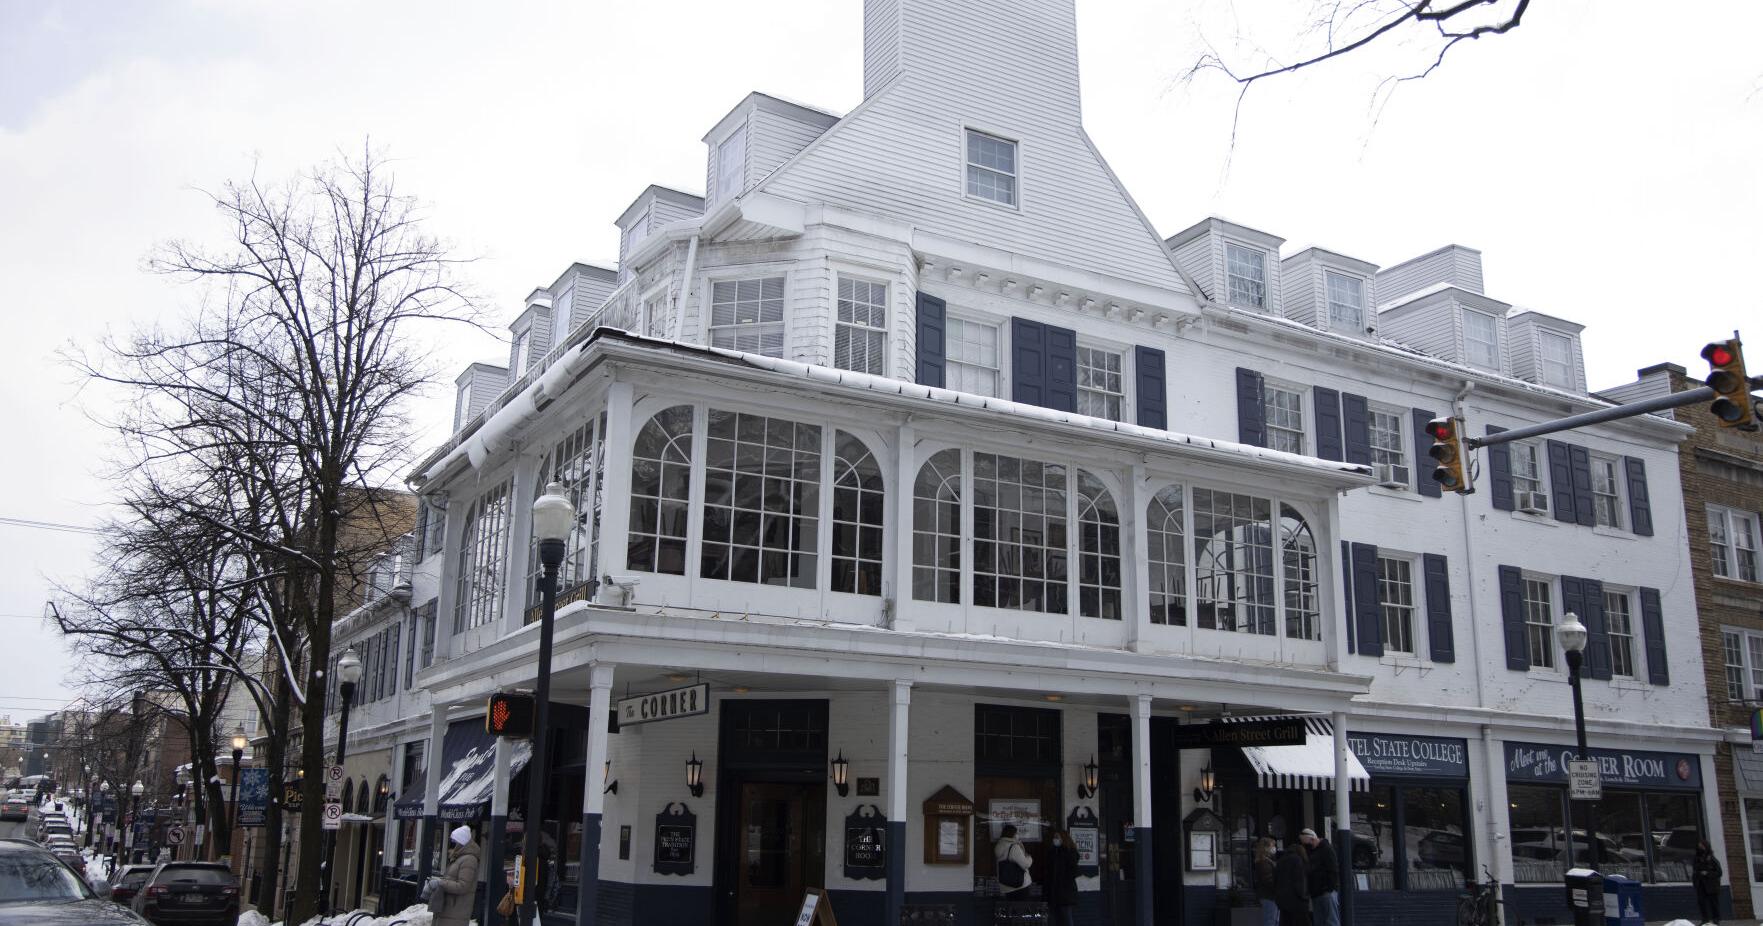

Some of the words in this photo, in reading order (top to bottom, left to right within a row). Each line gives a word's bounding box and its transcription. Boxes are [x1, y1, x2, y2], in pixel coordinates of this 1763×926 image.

[641, 689, 697, 719] CORNER
[1214, 728, 1238, 742] Allen
[1240, 727, 1271, 742] Street
[1273, 725, 1298, 740] Grill
[1347, 738, 1371, 756] TEL
[1373, 737, 1409, 757] STATE
[1411, 740, 1462, 764] COLLEGE
[1510, 748, 1535, 772] Meet
[1534, 761, 1543, 776] at
[1544, 756, 1557, 775] the
[1622, 754, 1665, 778] ROOM
[851, 844, 881, 852] CORNR
